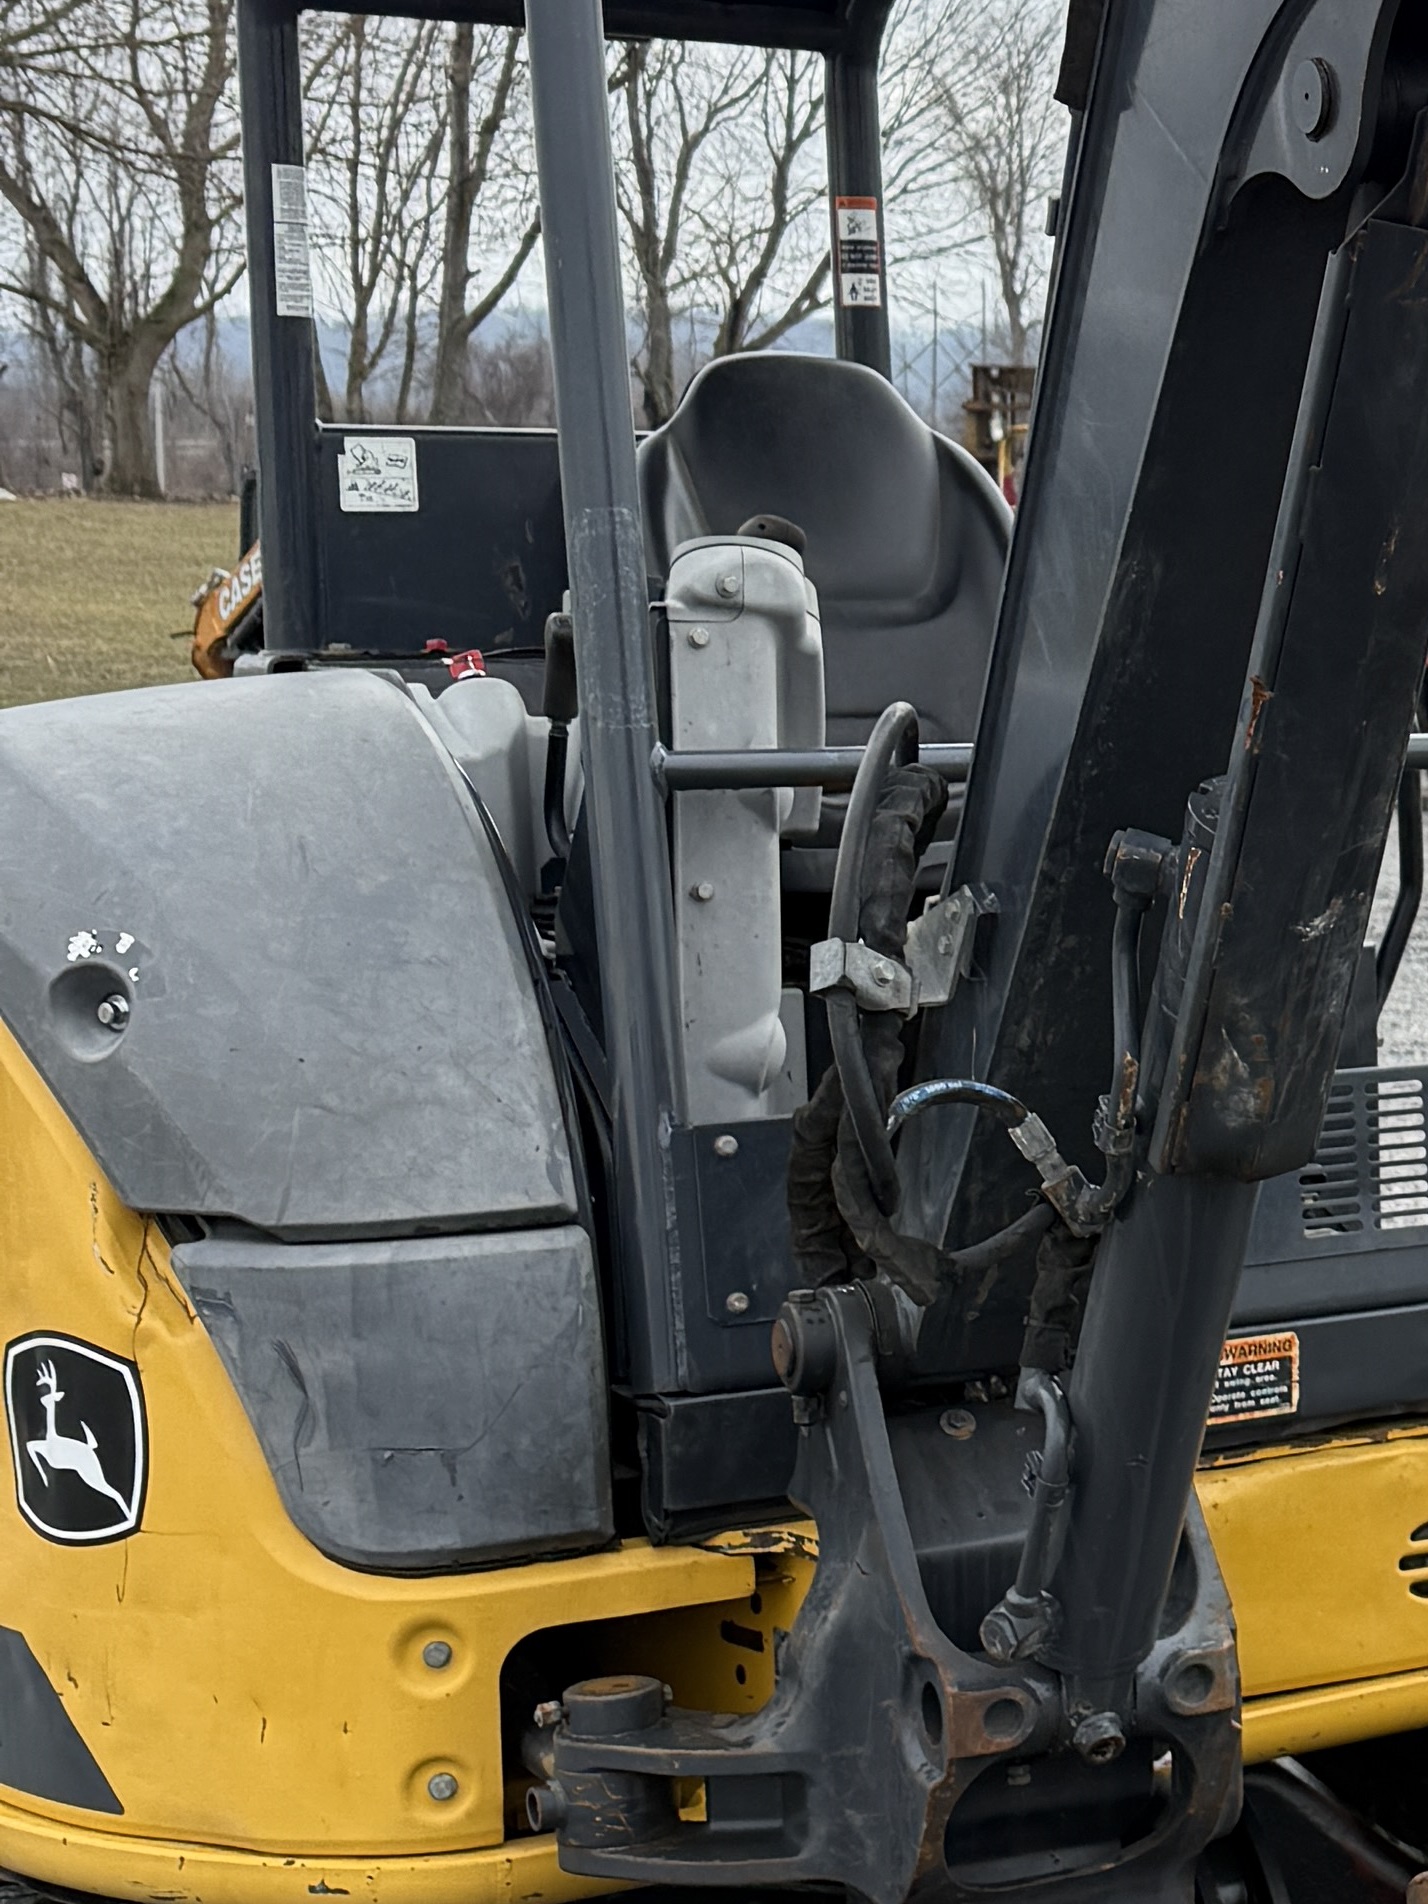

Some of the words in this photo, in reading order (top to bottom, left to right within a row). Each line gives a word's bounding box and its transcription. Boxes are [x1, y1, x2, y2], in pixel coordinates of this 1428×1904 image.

[219, 549, 262, 621] CASE
[1223, 1339, 1292, 1359] WARNING
[1217, 1366, 1239, 1378] TAY
[1243, 1360, 1280, 1375] CLEAR
